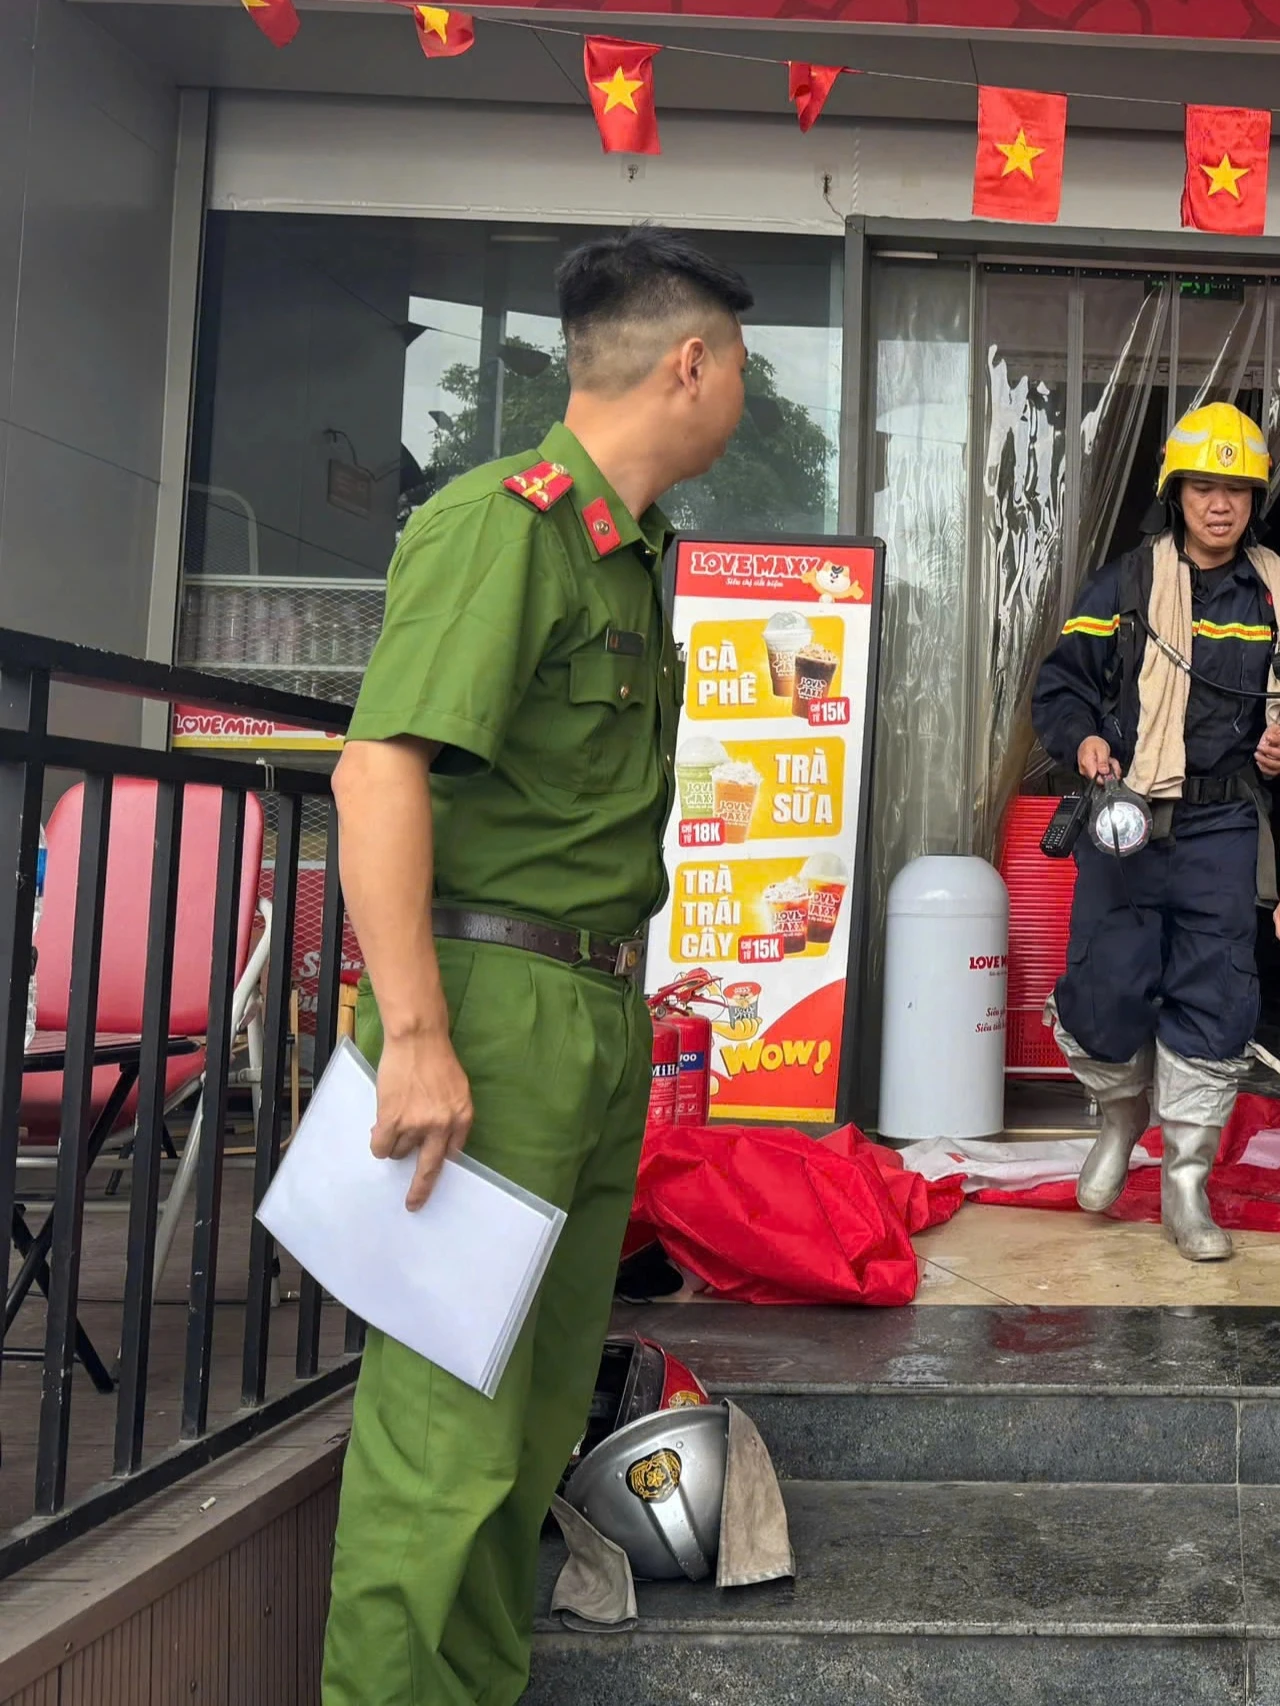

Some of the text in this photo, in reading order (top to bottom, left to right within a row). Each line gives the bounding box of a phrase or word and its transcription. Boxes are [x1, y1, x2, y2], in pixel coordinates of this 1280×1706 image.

[697, 639, 738, 672] CÀ
[697, 672, 757, 706] PHÊ
[821, 701, 846, 721] 15K
[774, 746, 828, 785] TRÀ
[773, 786, 833, 825] SỮA
[692, 822, 721, 843] 18K
[681, 863, 733, 896] TRÀ
[681, 895, 741, 928] TRÁI
[680, 926, 734, 959] CÂY
[753, 938, 780, 959] 15K
[969, 955, 1000, 970] LOVE
